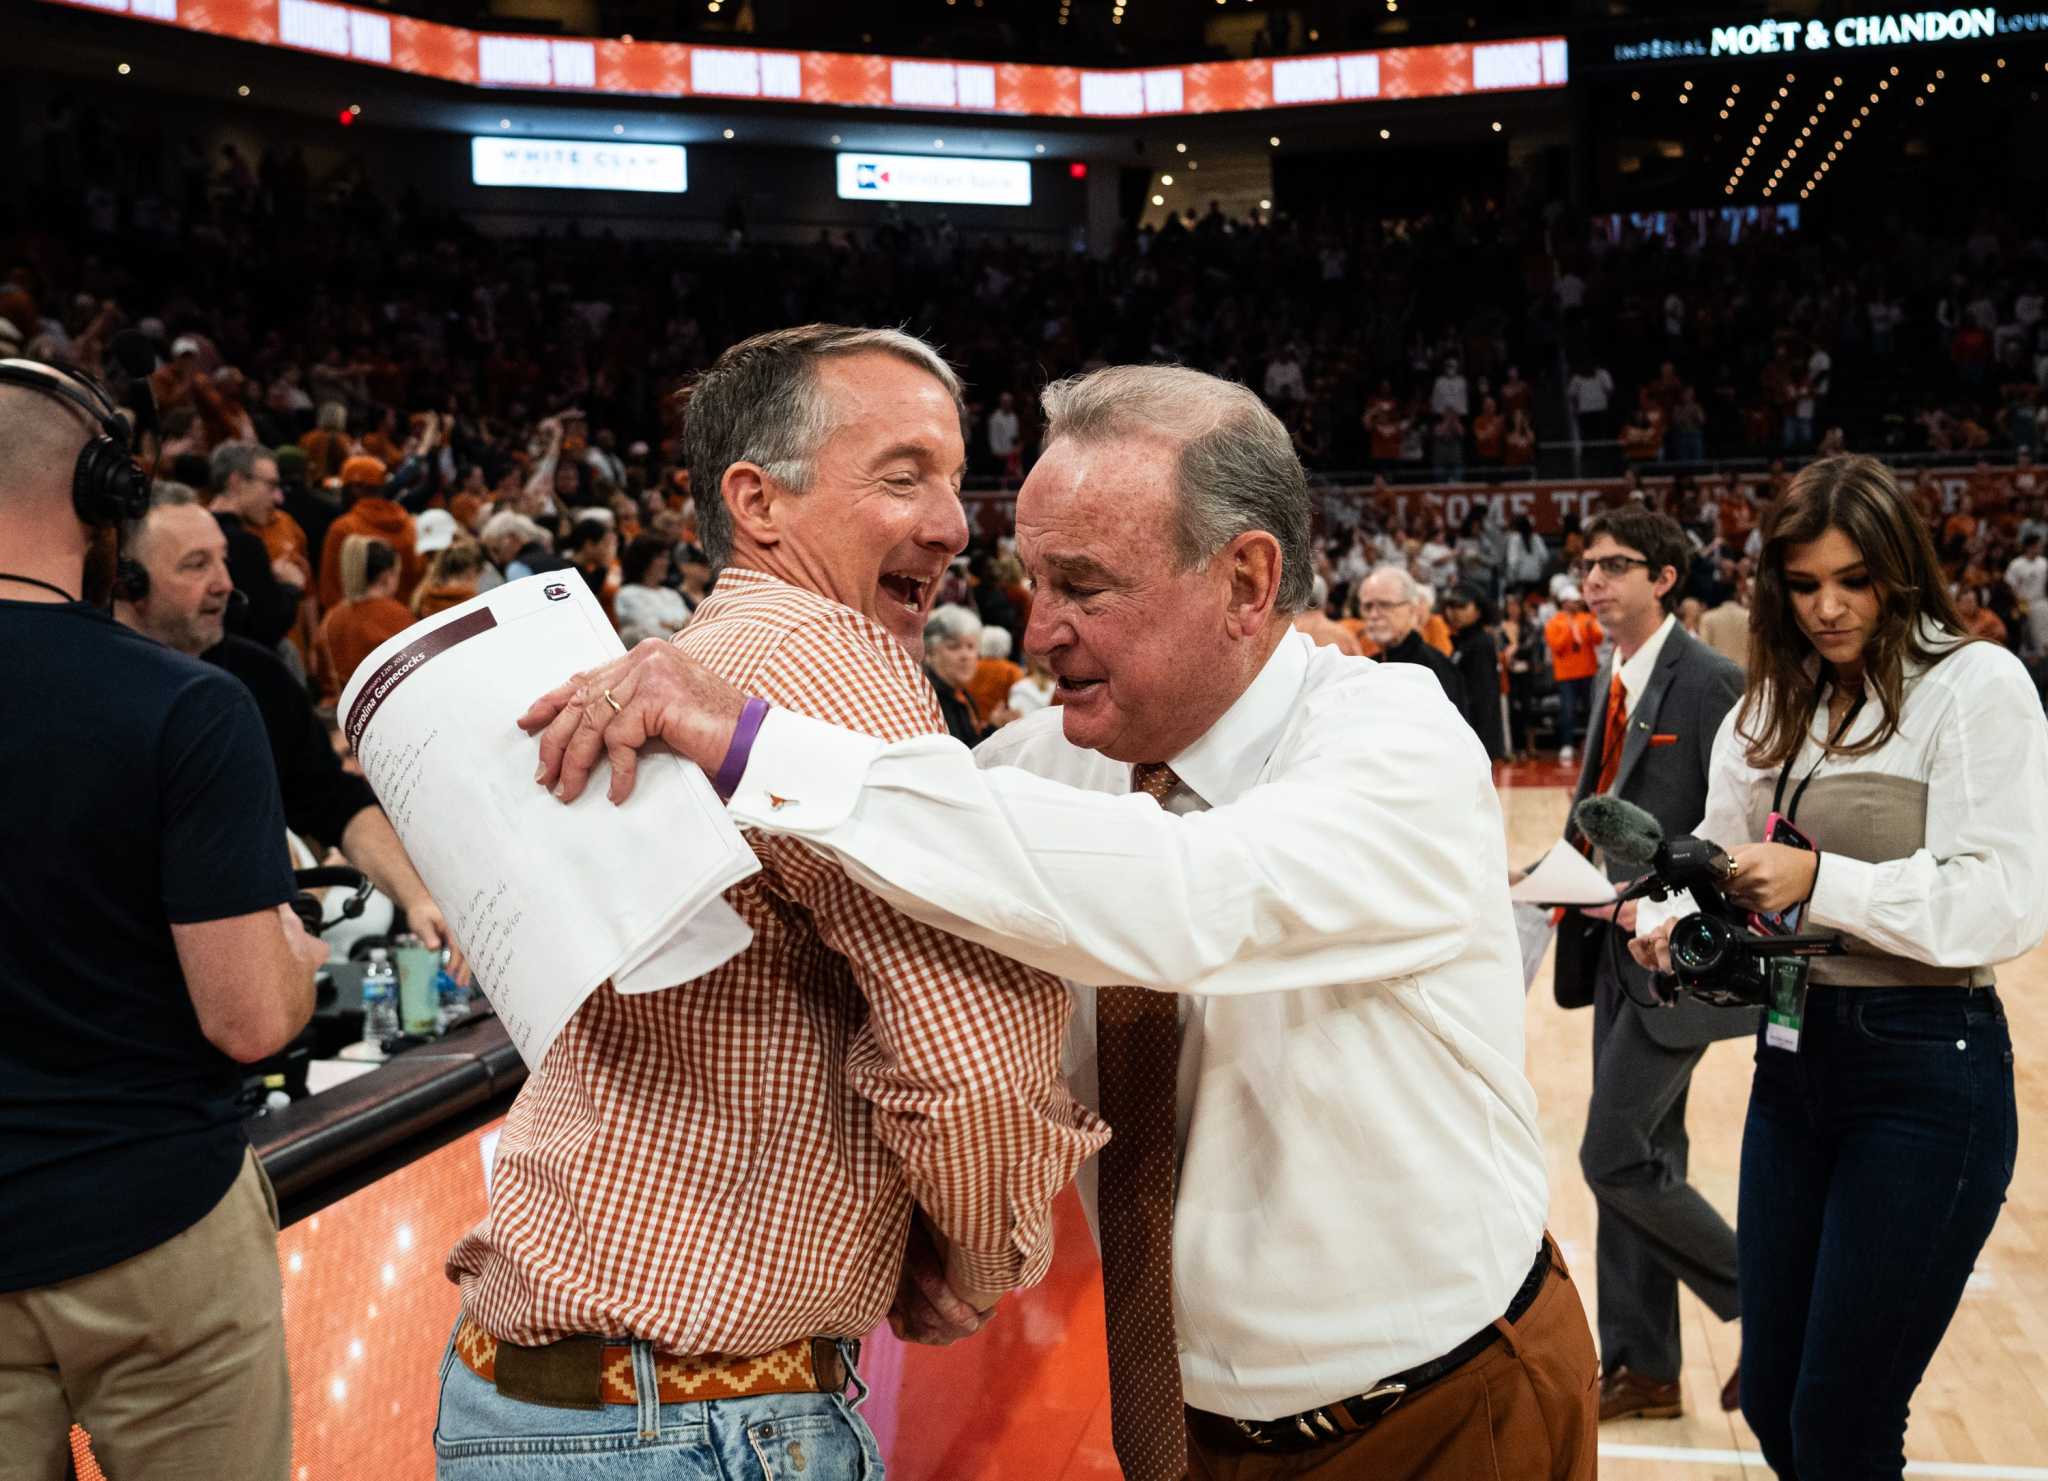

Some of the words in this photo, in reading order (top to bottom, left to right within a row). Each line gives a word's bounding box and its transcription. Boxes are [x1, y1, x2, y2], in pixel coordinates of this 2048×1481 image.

[1710, 18, 1801, 56] MOËT
[1805, 19, 1830, 50] &
[1834, 7, 1996, 48] CHANDON
[353, 697, 377, 736] Carolina
[374, 651, 426, 698] Gamecocks
